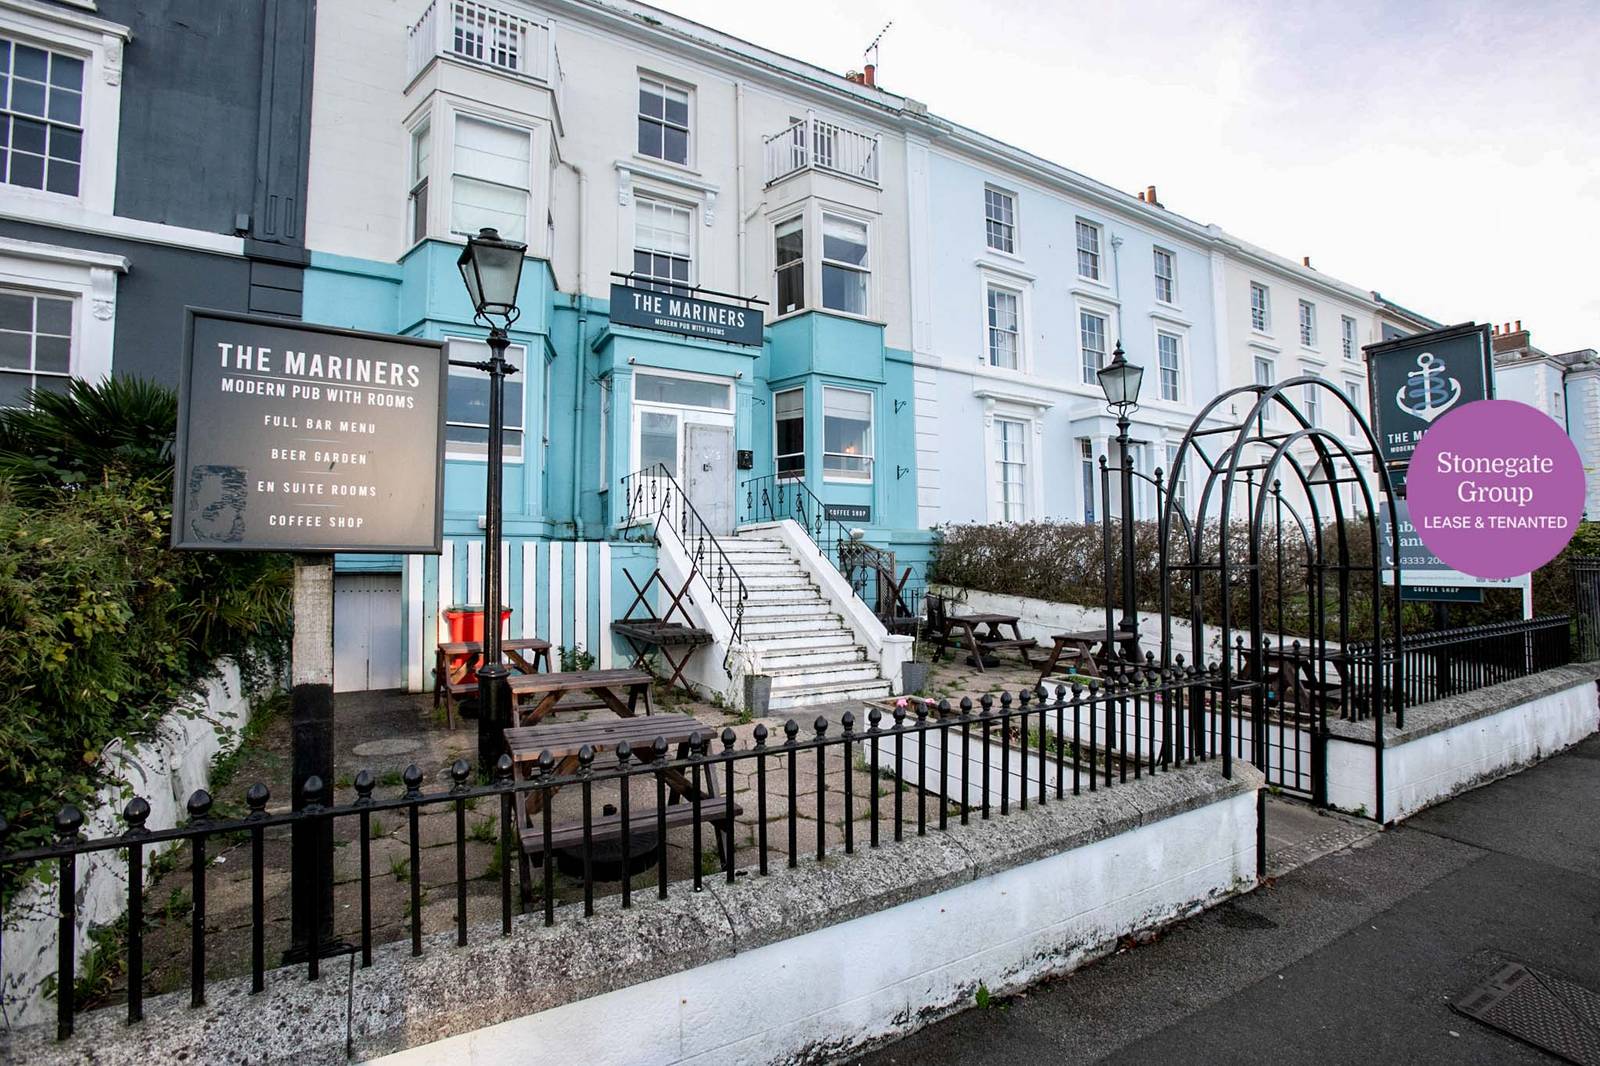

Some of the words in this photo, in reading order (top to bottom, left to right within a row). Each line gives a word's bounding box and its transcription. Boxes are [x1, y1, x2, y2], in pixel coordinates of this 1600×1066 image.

[633, 293, 662, 313] THE
[669, 299, 745, 328] MARINERS
[655, 318, 678, 328] MODERN
[679, 322, 690, 330] PUB
[691, 324, 705, 333] WITH
[706, 326, 725, 336] ROOMS
[218, 343, 272, 372] THE
[285, 350, 420, 388] MARINERS
[221, 377, 286, 398] MODERN
[292, 385, 320, 400] PUB
[327, 388, 362, 404] WITH
[368, 392, 415, 409] ROOMS
[264, 415, 298, 429] FULL
[306, 418, 332, 431] BAR
[340, 421, 375, 434] MENU
[1388, 432, 1409, 444] THE
[1413, 430, 1428, 441] M
[271, 448, 306, 461] BEER
[314, 451, 367, 465] GARDEN
[257, 481, 275, 493] EN
[283, 482, 324, 494] SUITE
[332, 484, 376, 497] ROOMS
[269, 515, 322, 527] COFFEE
[329, 516, 364, 528] SHOP
[829, 509, 850, 517] COFFEE
[1398, 556, 1425, 565] 3333
[1427, 556, 1446, 565] 20
